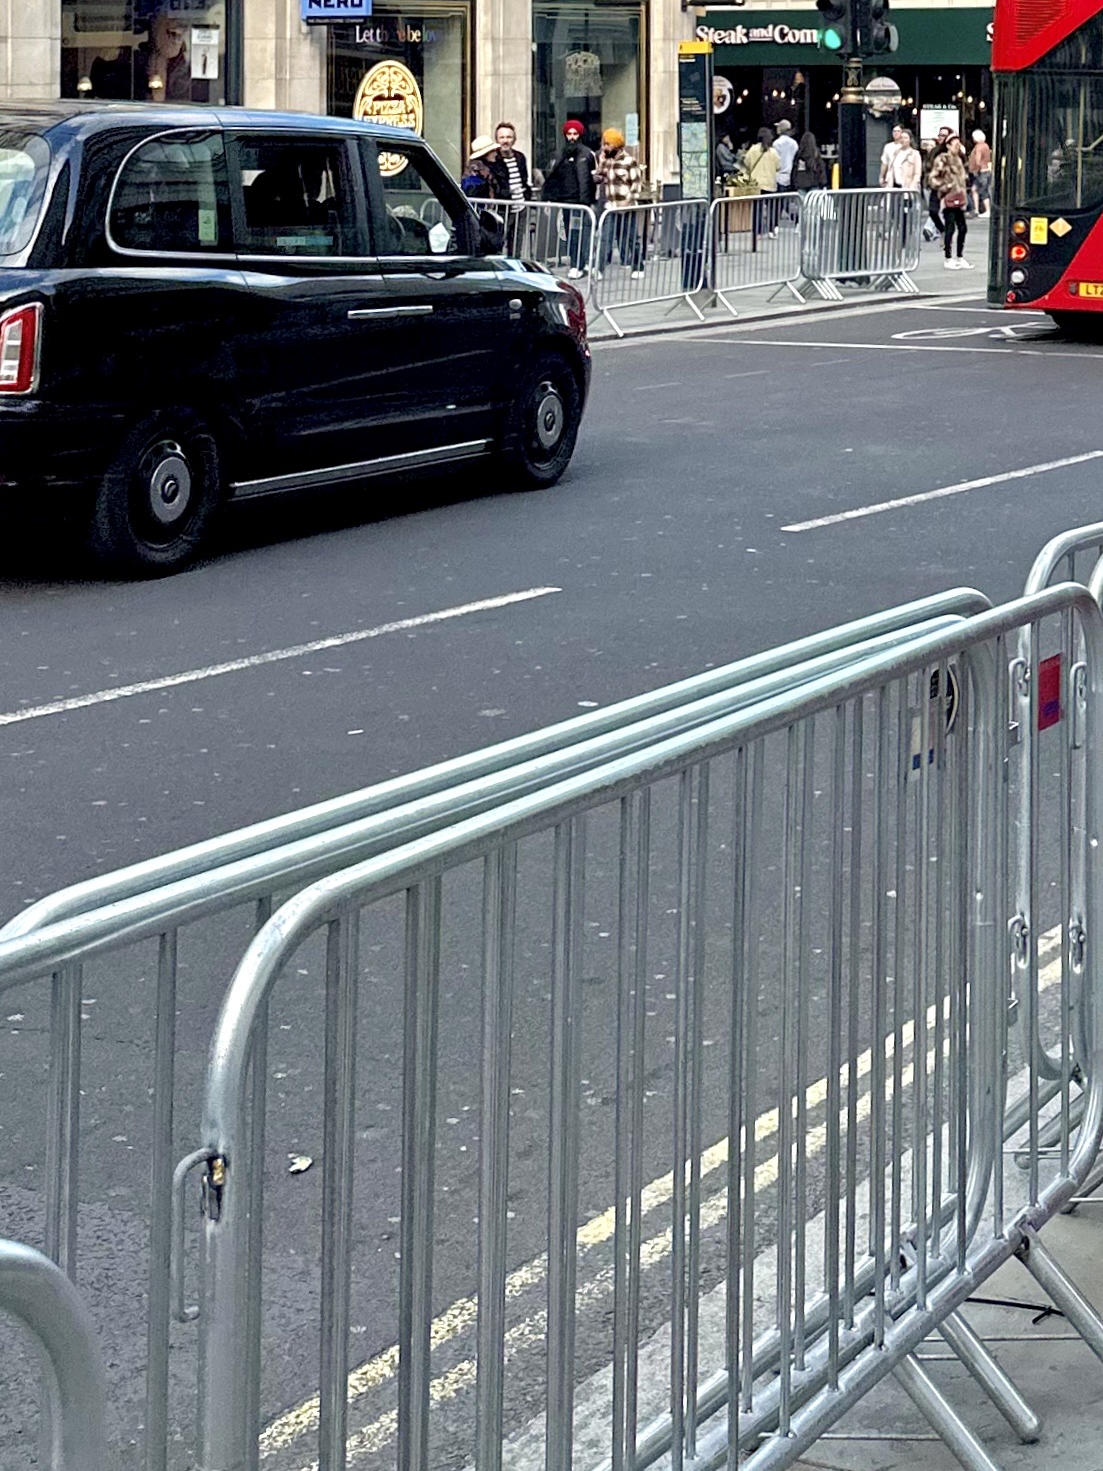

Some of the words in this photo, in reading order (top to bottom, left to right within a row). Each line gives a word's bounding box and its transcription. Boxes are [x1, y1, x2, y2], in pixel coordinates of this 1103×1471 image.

[355, 25, 374, 44] Let
[407, 24, 422, 43] be
[696, 24, 749, 44] Steak
[749, 23, 774, 41] and
[774, 24, 821, 49] Com
[372, 100, 407, 115] PIZZA
